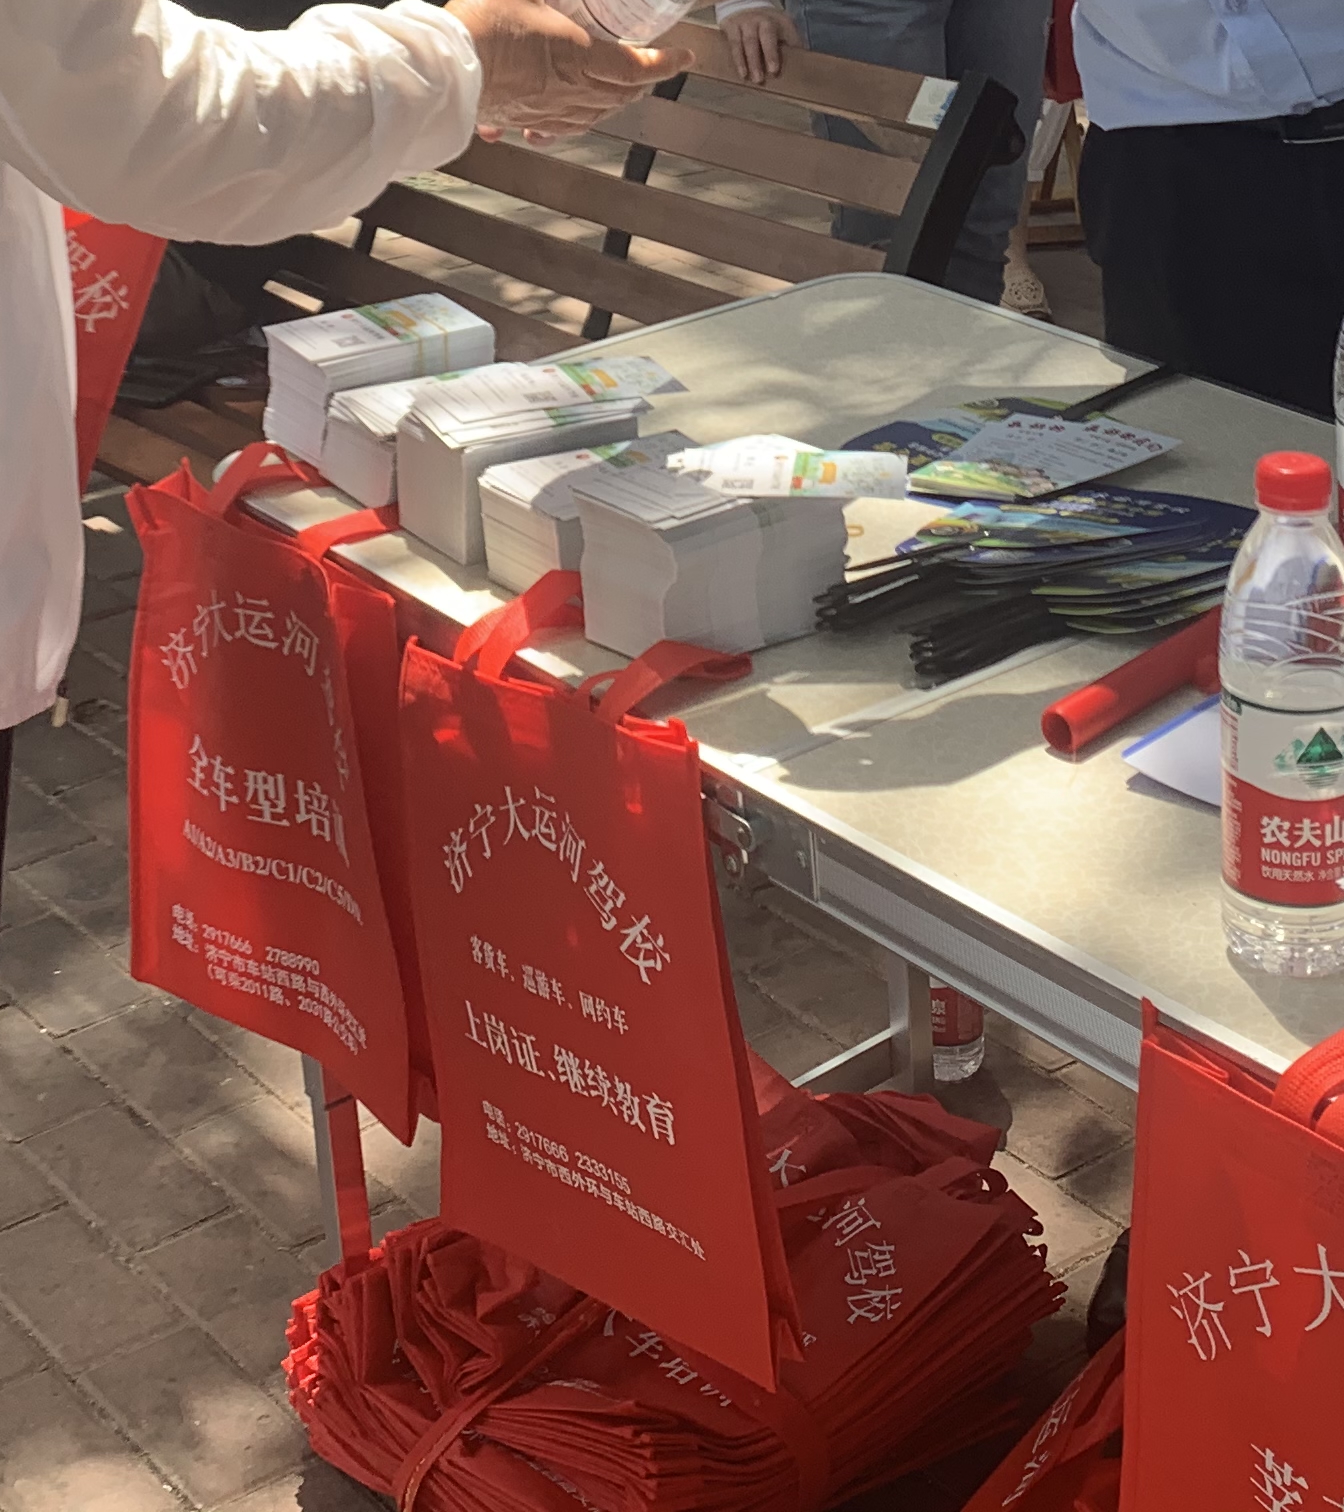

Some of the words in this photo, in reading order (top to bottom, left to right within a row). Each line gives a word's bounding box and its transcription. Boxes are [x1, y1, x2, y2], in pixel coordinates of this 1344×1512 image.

[187, 734, 350, 869] 全车型培
[1260, 846, 1321, 867] NONGFU
[442, 785, 671, 985] 济宁大运河驾校
